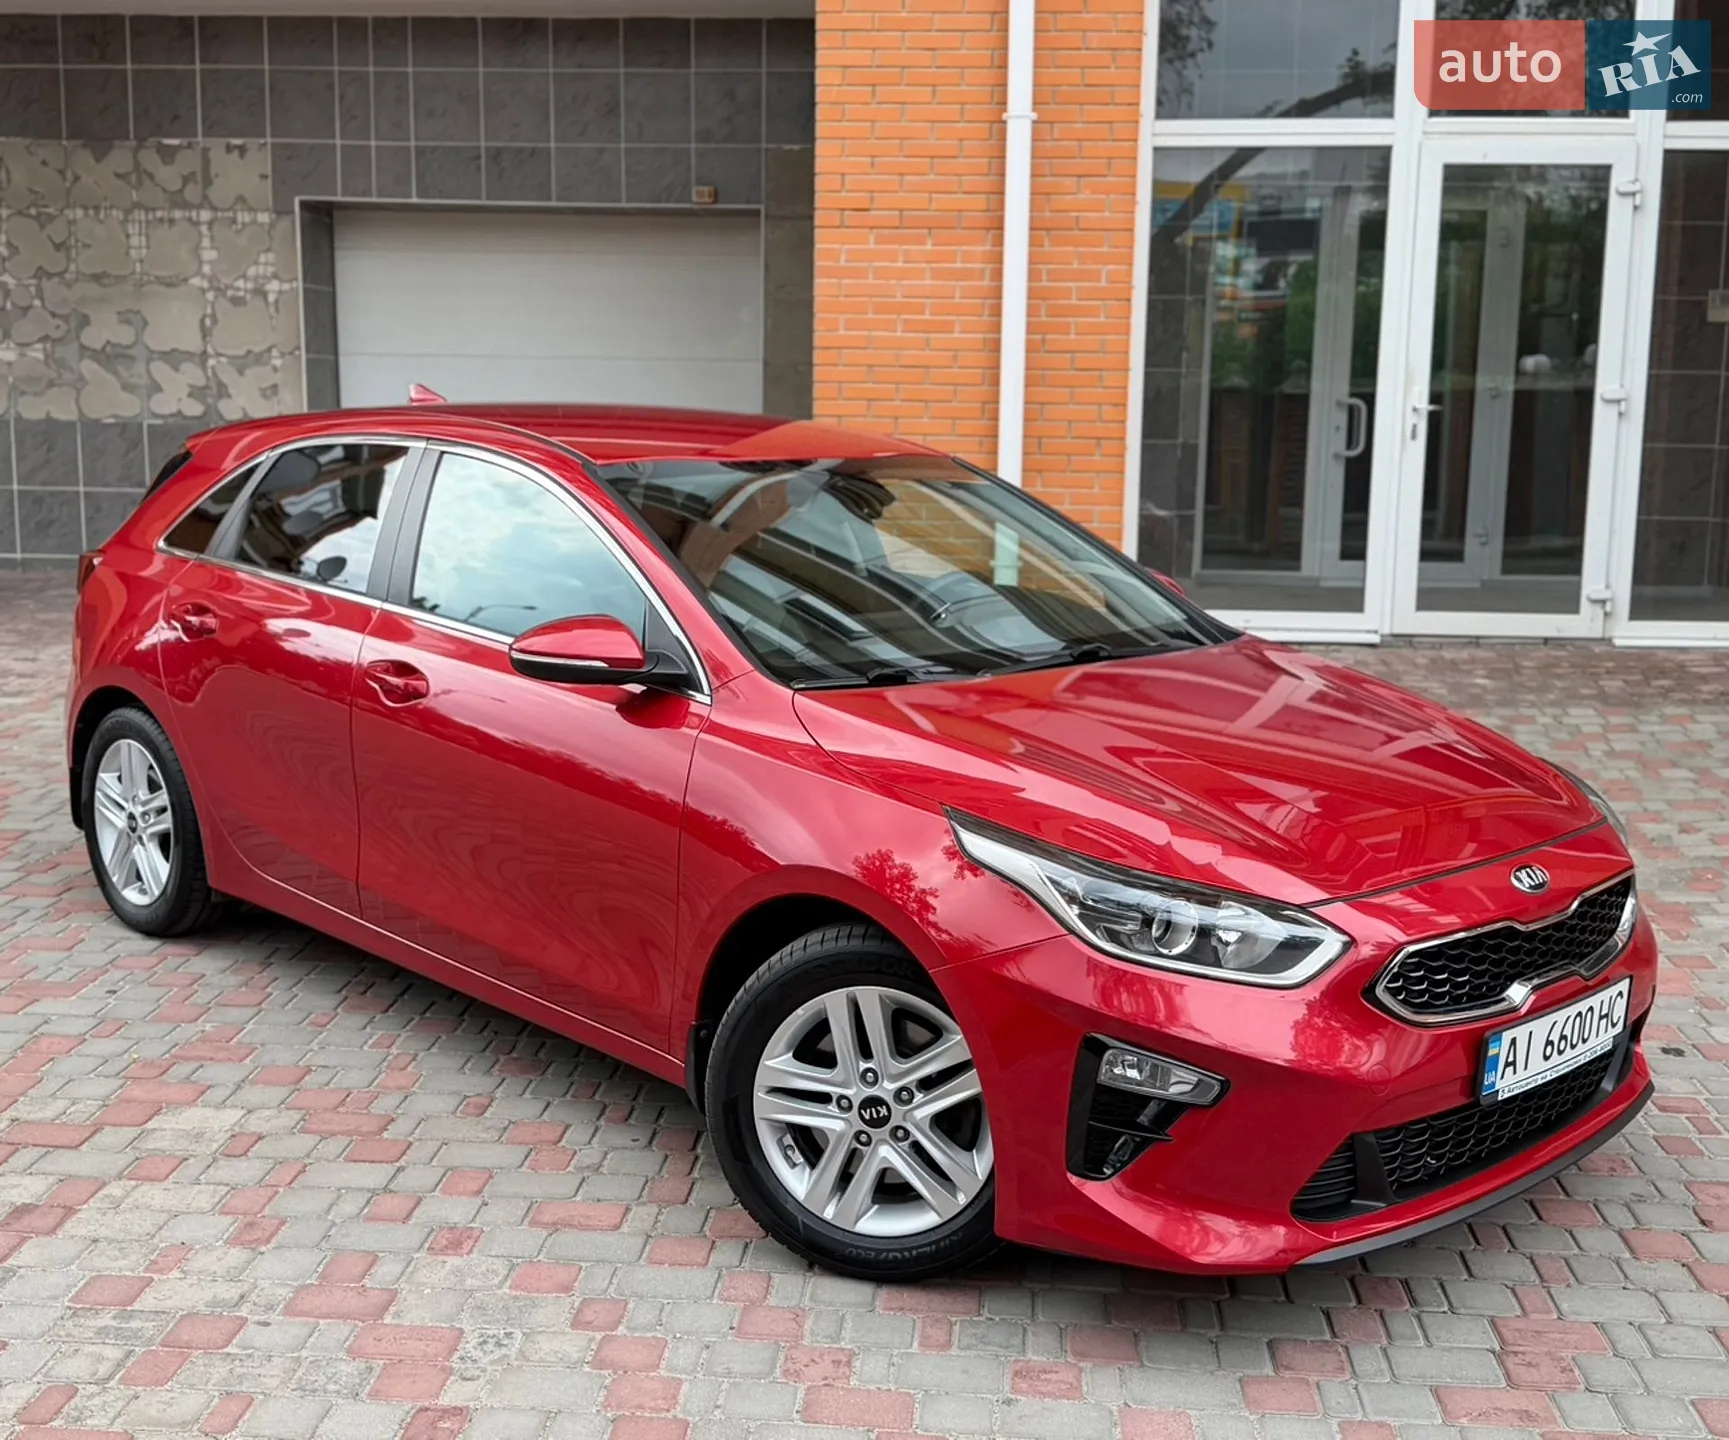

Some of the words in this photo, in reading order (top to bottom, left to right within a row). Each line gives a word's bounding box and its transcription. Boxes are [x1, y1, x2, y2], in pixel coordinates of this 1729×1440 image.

[1515, 866, 1548, 888] KIA
[1500, 1031, 1533, 1080] AI
[1543, 1005, 1595, 1062] 6600
[1596, 990, 1624, 1039] HC
[1484, 1070, 1496, 1085] UA
[860, 1105, 888, 1120] KIA
